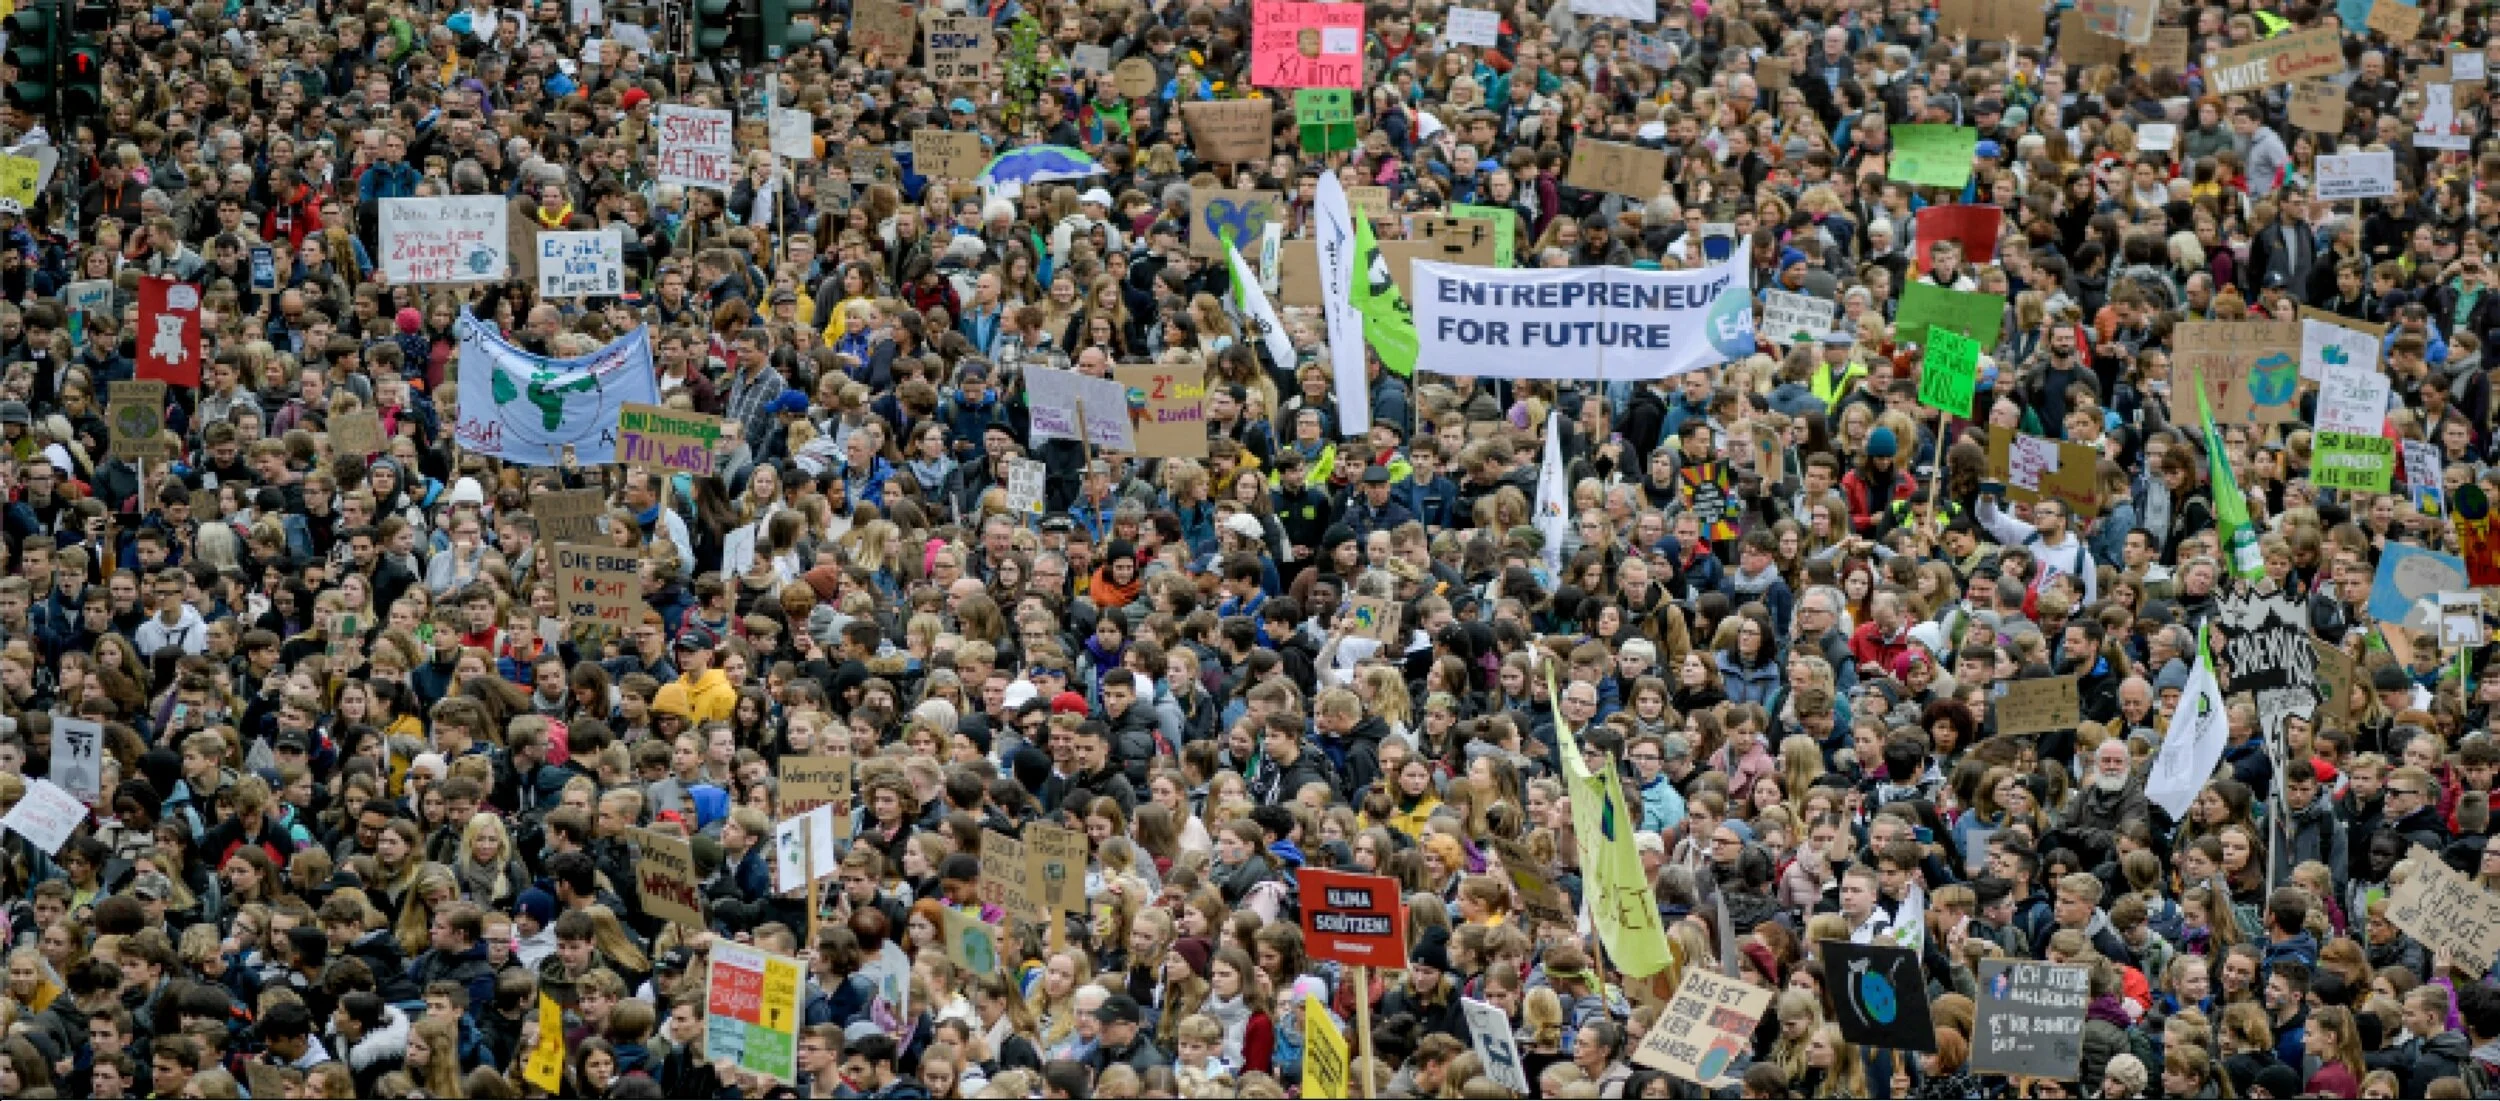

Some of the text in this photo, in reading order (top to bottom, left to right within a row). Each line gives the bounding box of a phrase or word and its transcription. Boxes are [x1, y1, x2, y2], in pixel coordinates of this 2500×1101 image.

[930, 33, 979, 49] SNOW
[935, 64, 953, 79] GO
[1271, 52, 1356, 86] Klima
[2212, 57, 2271, 95] WHITE
[663, 114, 726, 145] START
[658, 147, 728, 181] ACTING
[607, 268, 620, 291] B
[1437, 316, 1671, 349] FOR FUTURE
[599, 427, 618, 448] A
[624, 434, 654, 461] TU
[559, 550, 637, 574] DIE ERDE
[568, 601, 631, 624] VOR WUT
[781, 764, 845, 795] Warning
[1327, 888, 1371, 908] KLIMA
[1315, 911, 1389, 935] SCHÜTZEN!
[2418, 886, 2490, 950] CHANGE
[2013, 963, 2041, 986] ICH
[1685, 974, 1749, 1008] DAS IST
[1671, 996, 1708, 1021] EINE
[1661, 1015, 1694, 1038] KEIN
[1645, 1033, 1700, 1067] WANDEL
